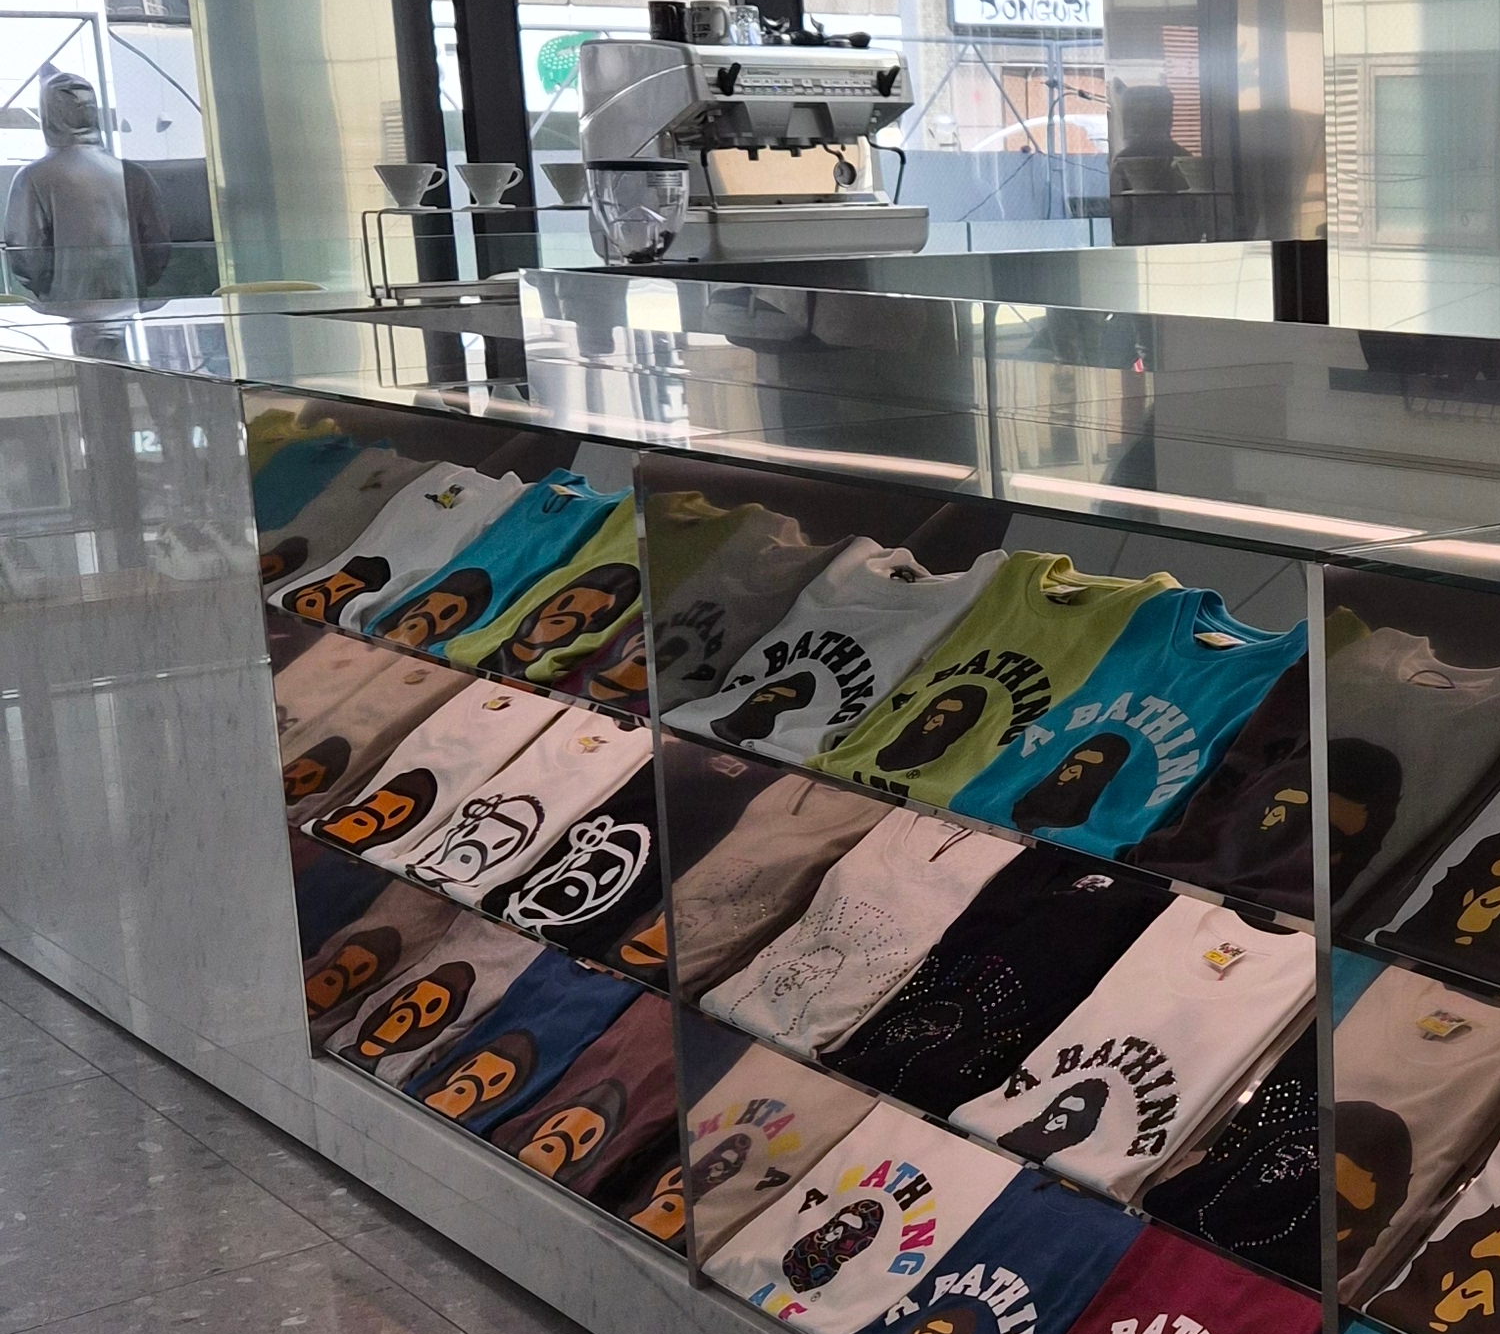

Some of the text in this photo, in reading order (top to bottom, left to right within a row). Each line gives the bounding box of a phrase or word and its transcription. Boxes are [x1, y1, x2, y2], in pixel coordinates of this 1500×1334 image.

[763, 631, 874, 726] BATHING
[1020, 724, 1056, 758] A
[1065, 692, 1200, 808] BATHING
[1003, 1035, 1180, 1157] A BATHING
[798, 1188, 829, 1214] A
